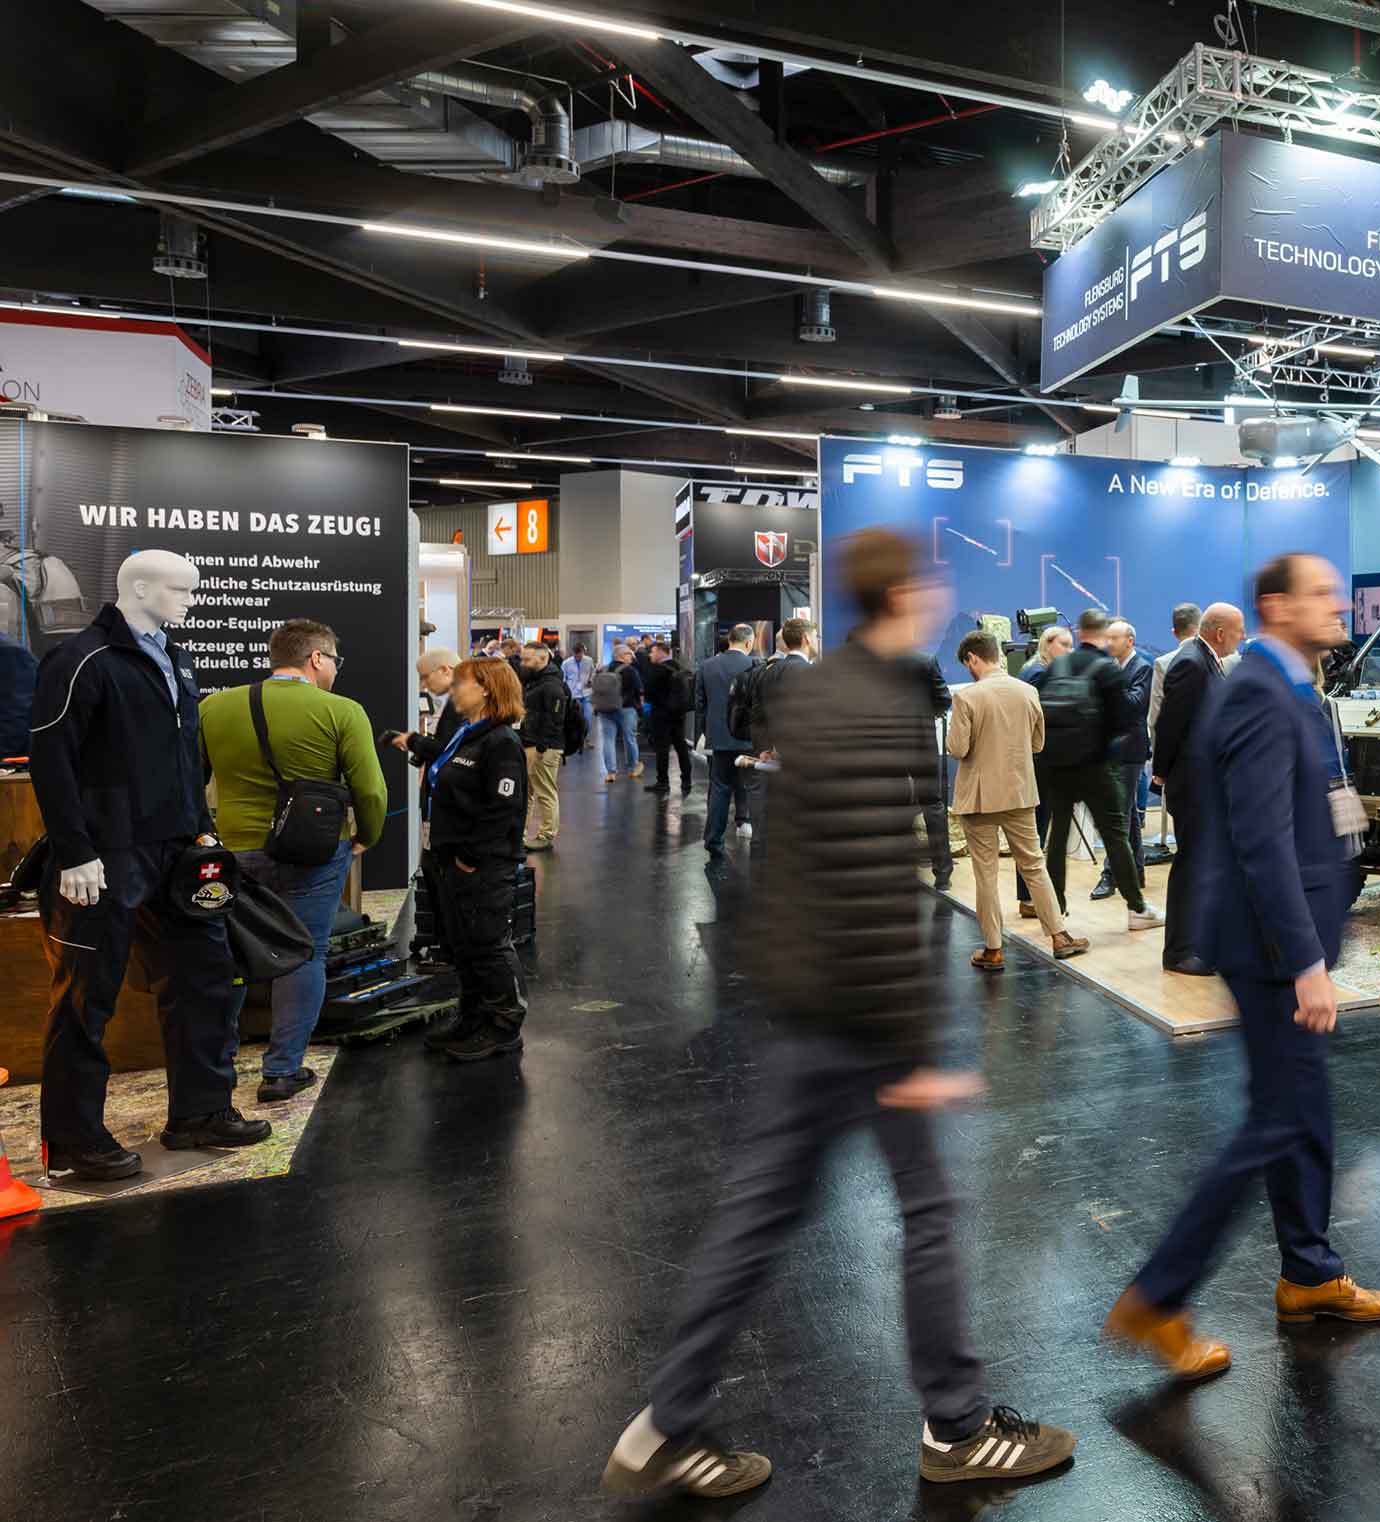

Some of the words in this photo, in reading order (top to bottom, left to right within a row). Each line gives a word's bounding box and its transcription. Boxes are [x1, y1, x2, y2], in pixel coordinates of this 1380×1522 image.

[1131, 212, 1206, 302] FTS
[1084, 266, 1124, 308] FLENSBURG
[1053, 315, 1092, 352] TECHNOLOGY
[1092, 292, 1124, 328] SYSTEMS
[842, 453, 964, 489] FTS
[1108, 473, 1124, 494] A
[1130, 475, 1175, 496] New
[1181, 478, 1215, 499] Era
[1220, 480, 1241, 500] of
[1246, 481, 1330, 502] Defence.
[80, 505, 137, 527] WIR
[148, 507, 240, 532] HABEN
[250, 512, 299, 534] DAS
[307, 514, 382, 536] ZEUG!
[527, 509, 538, 544] 8
[229, 554, 258, 567] und
[261, 554, 320, 569] Abwehr
[191, 594, 271, 606] Workwear
[251, 577, 383, 596] Schutzausrüstung
